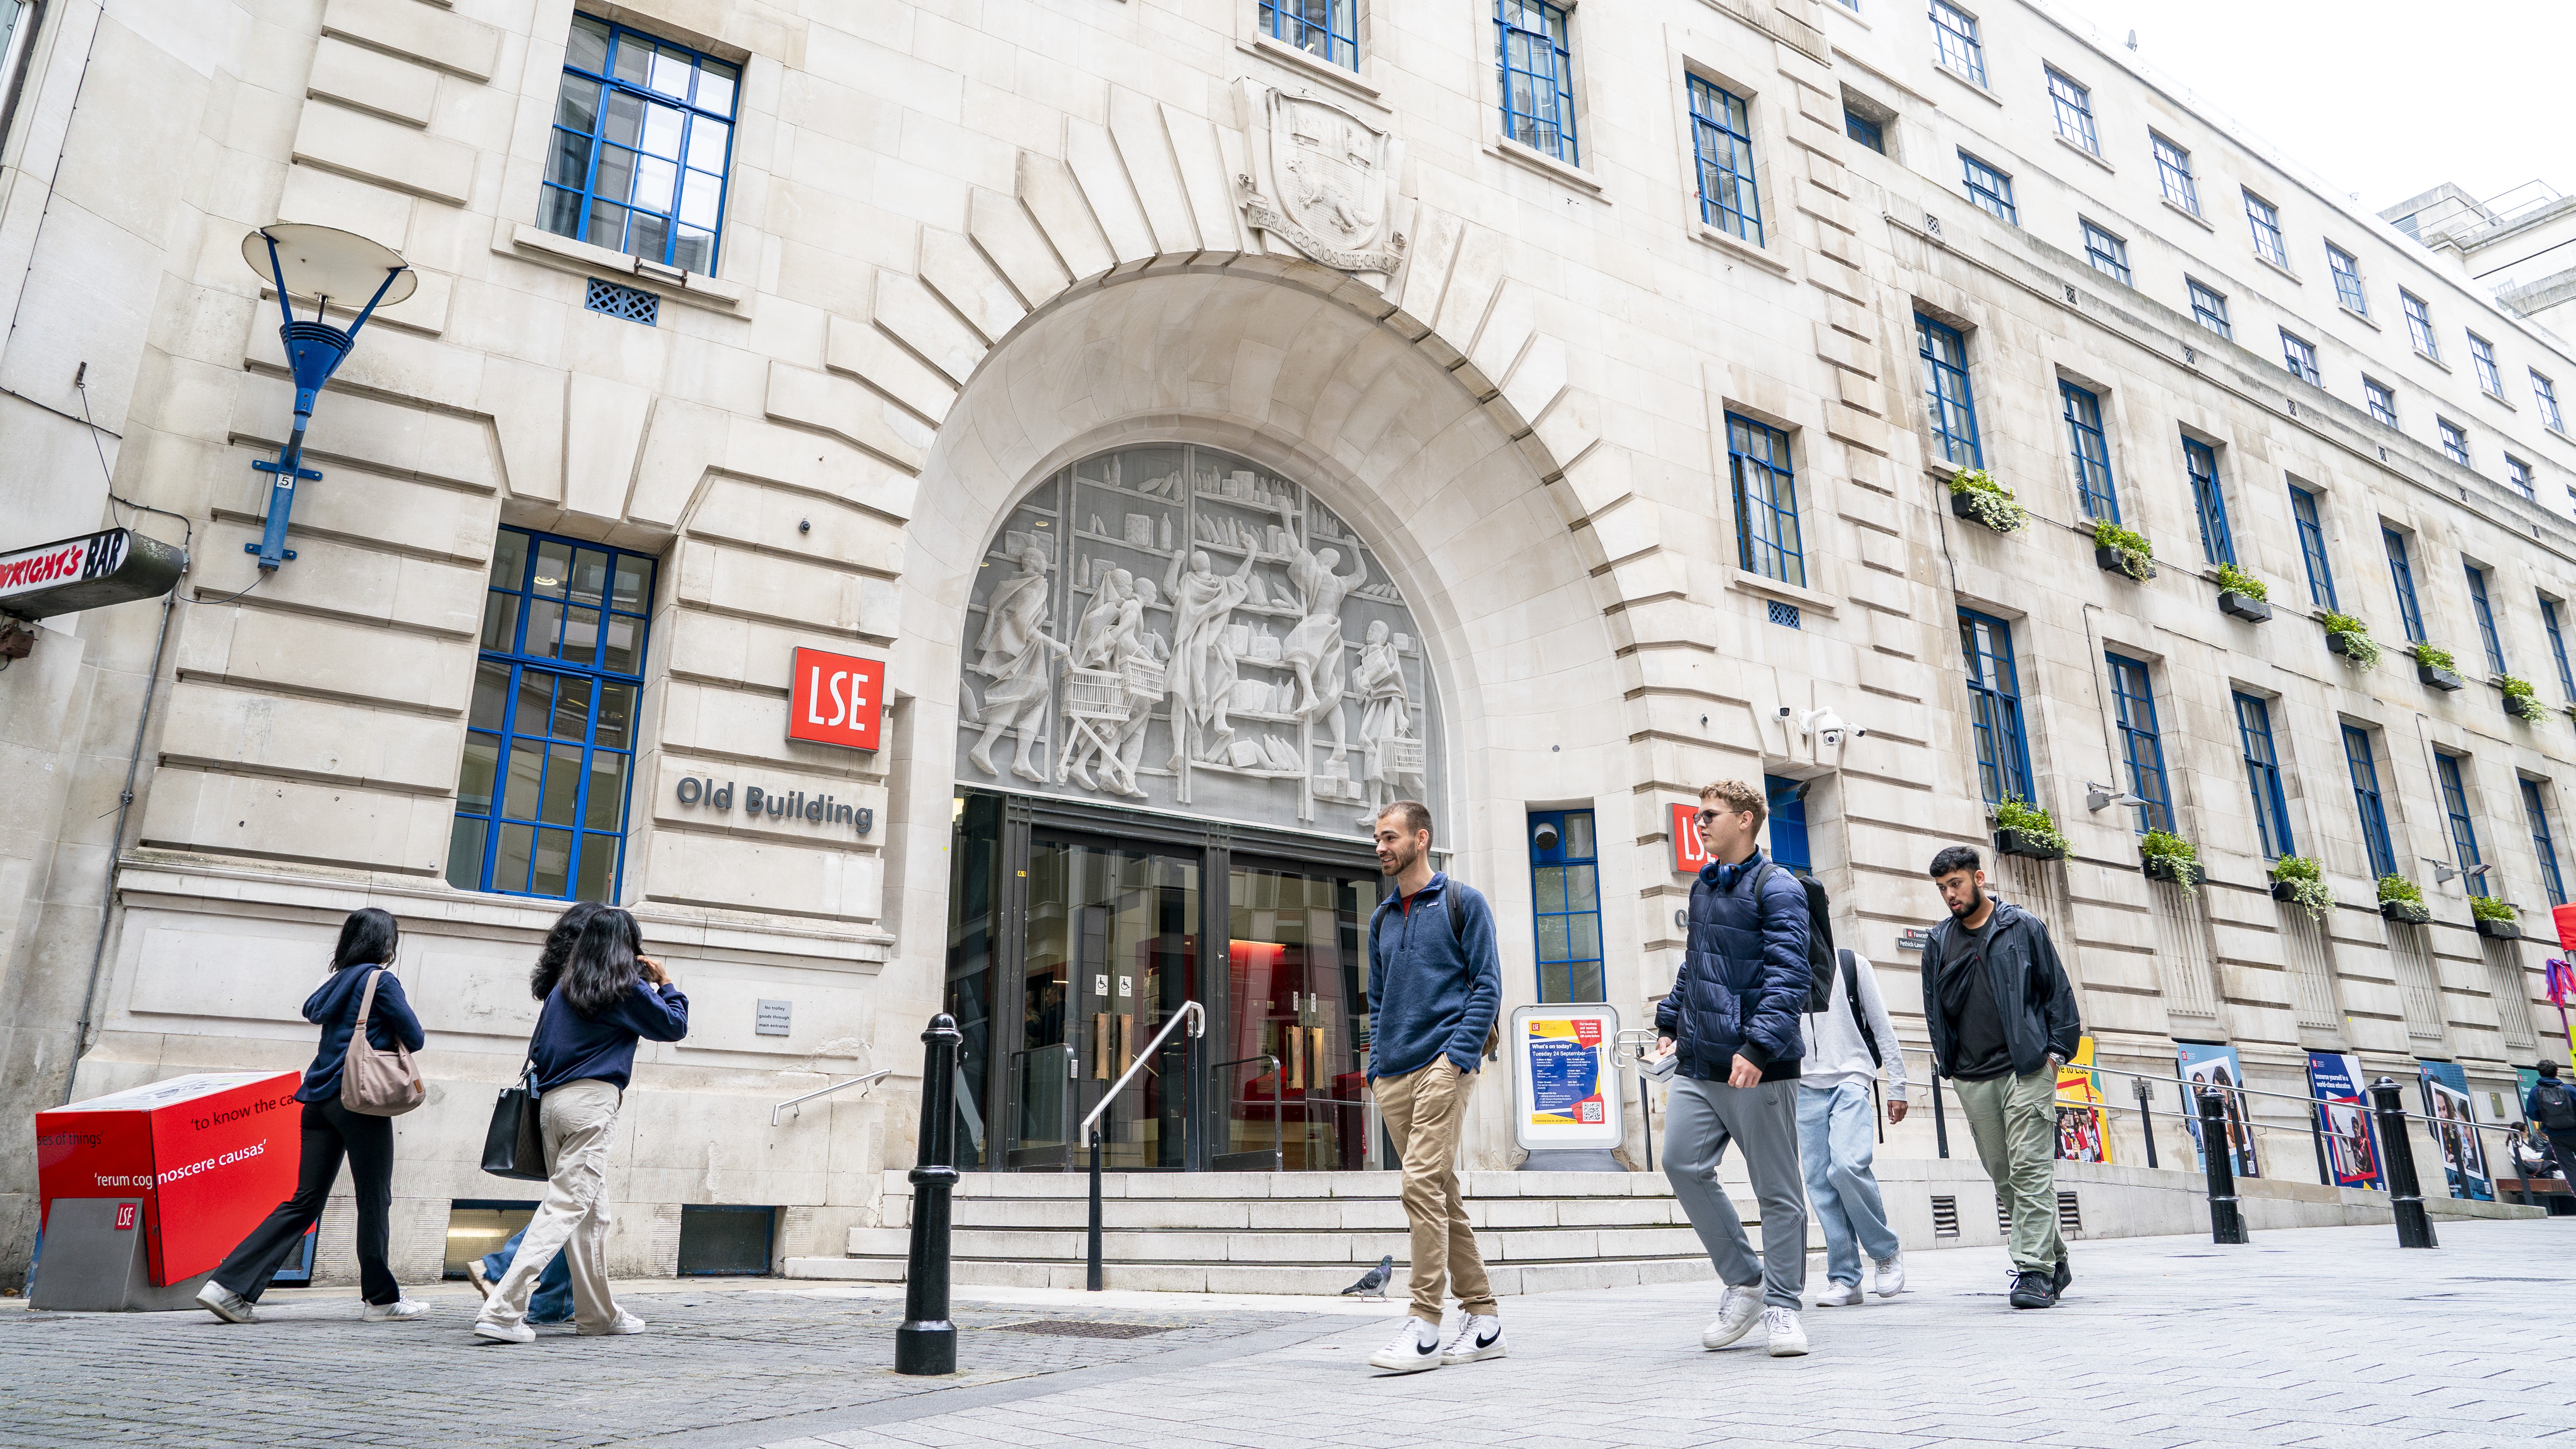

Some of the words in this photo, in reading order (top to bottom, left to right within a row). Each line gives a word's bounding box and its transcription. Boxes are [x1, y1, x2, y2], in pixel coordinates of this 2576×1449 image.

[1254, 209, 1293, 237] RERUM
[281, 477, 289, 486] 5
[81, 532, 124, 580] BAR
[808, 666, 868, 731] LSE
[677, 777, 734, 809] Old
[746, 786, 873, 833] Building
[1682, 817, 1716, 863] LS
[214, 1106, 251, 1126] know
[255, 1099, 276, 1113] the
[280, 1095, 294, 1106] ca
[37, 1135, 53, 1146] ses
[56, 1131, 66, 1145] of
[68, 1131, 103, 1148] things'
[158, 1158, 215, 1185] noscere
[219, 1139, 267, 1166] causas'
[94, 1173, 130, 1187] 'rerum
[133, 1175, 152, 1190] cog
[118, 1207, 133, 1226] LSE
